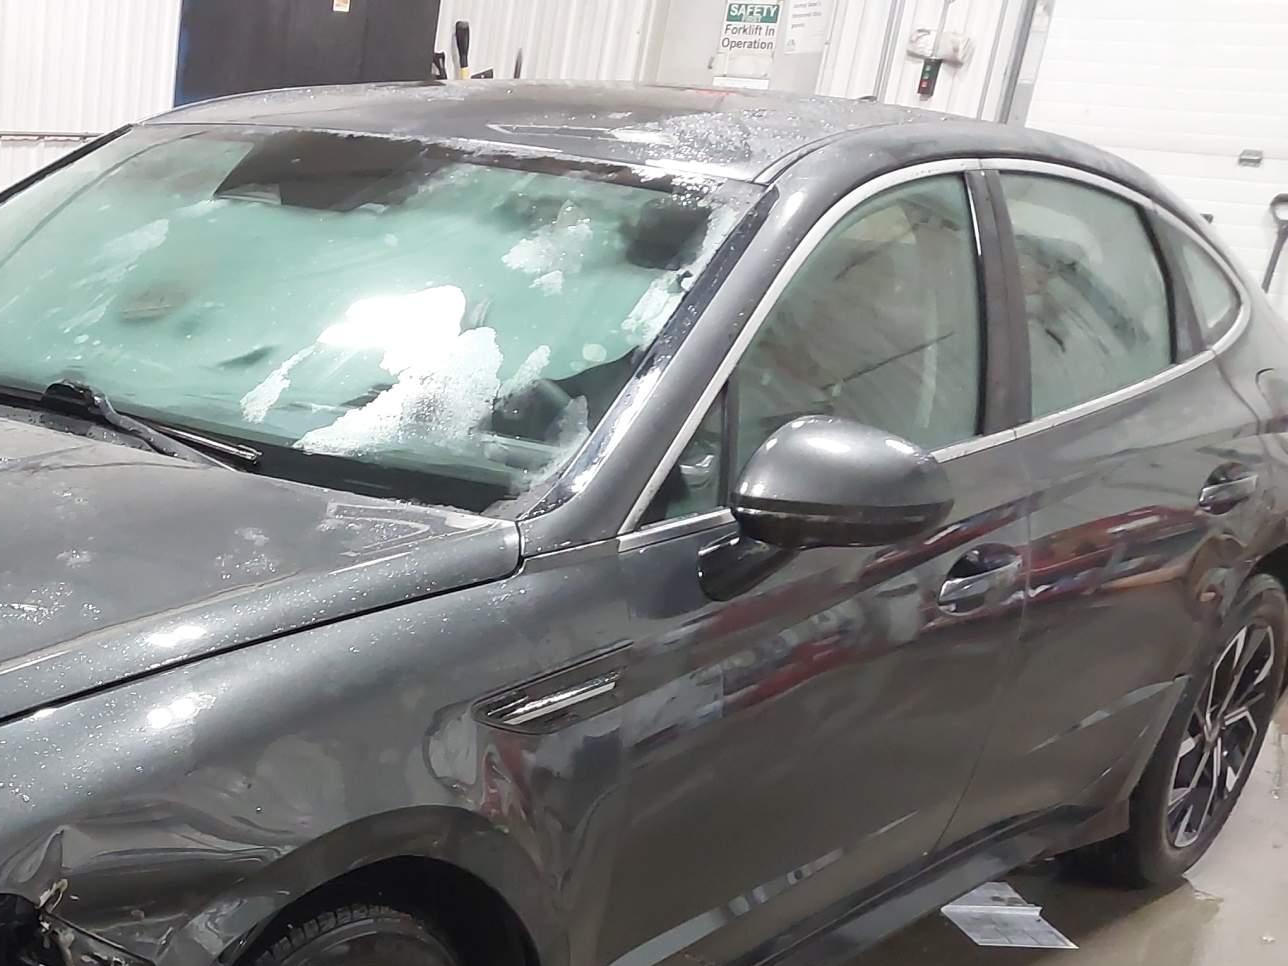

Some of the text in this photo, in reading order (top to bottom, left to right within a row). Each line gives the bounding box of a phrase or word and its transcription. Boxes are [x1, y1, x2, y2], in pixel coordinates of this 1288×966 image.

[729, 4, 777, 16] SAFETY
[724, 23, 775, 36] Forklift In
[721, 37, 773, 50] Operation
